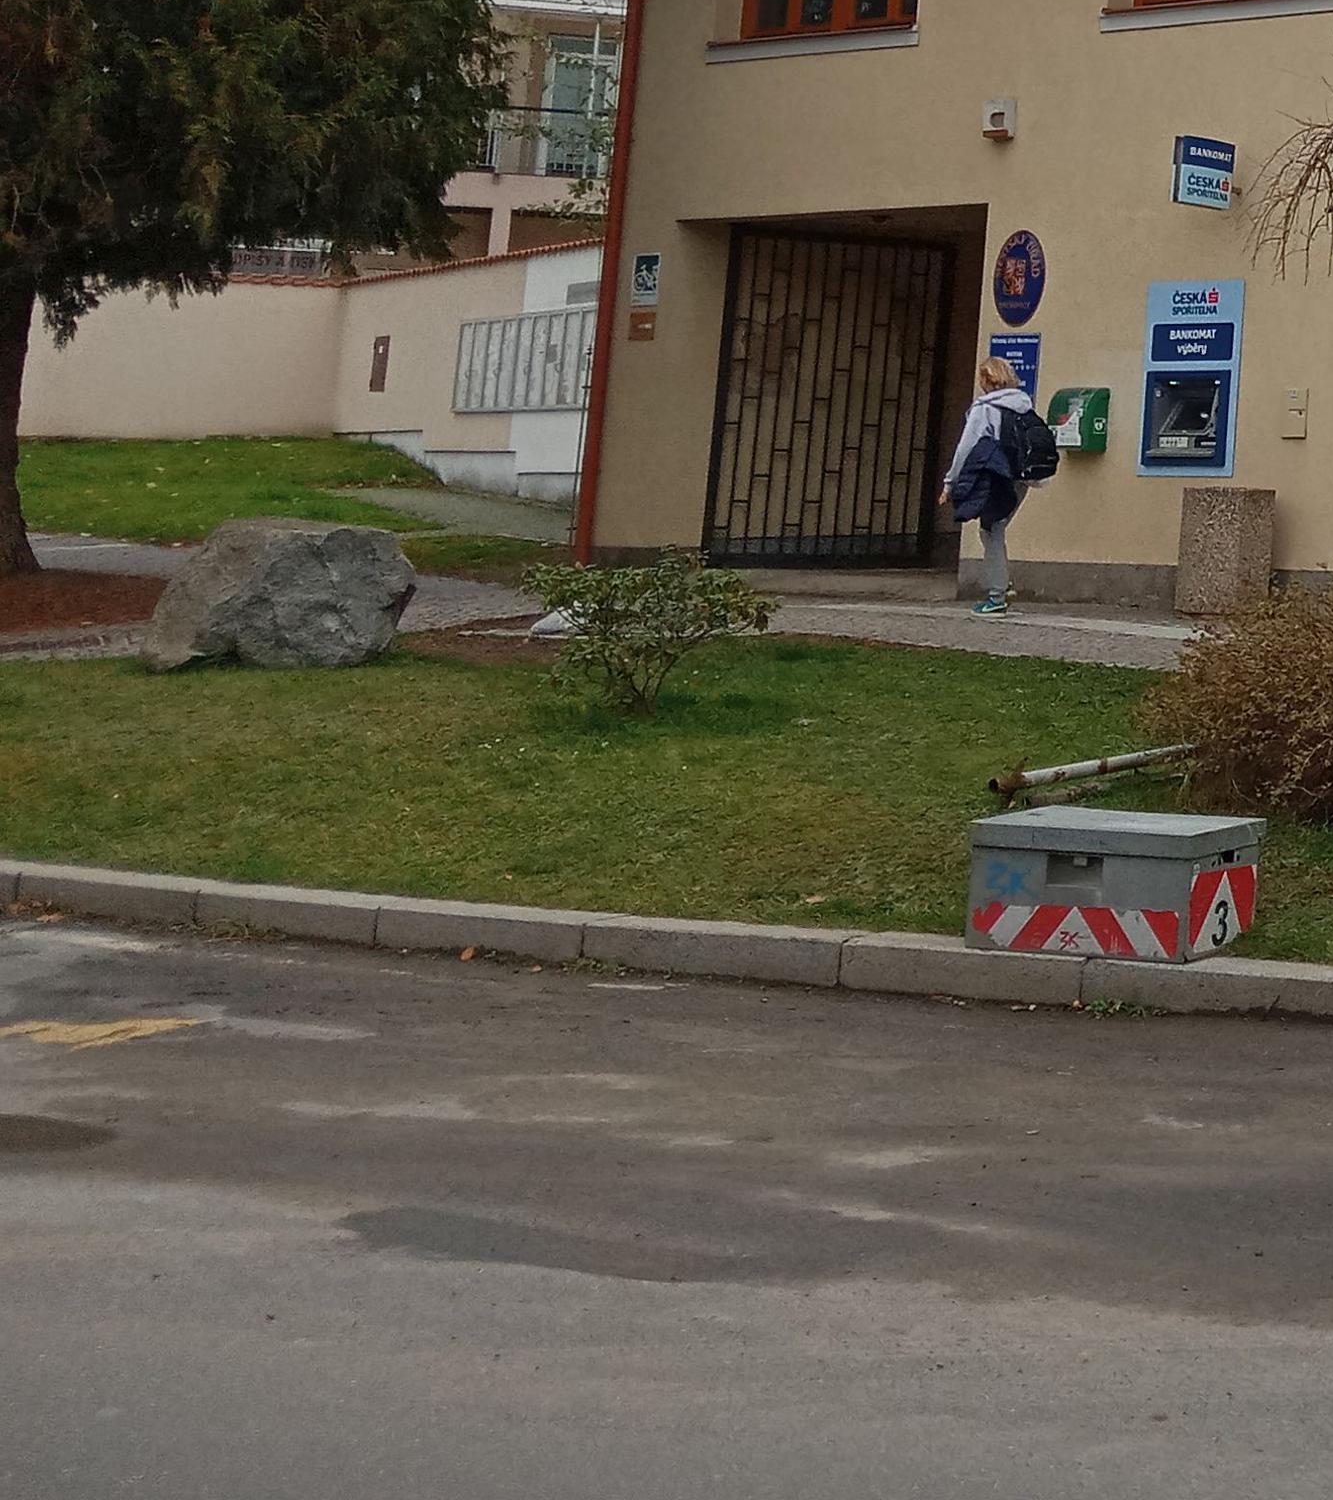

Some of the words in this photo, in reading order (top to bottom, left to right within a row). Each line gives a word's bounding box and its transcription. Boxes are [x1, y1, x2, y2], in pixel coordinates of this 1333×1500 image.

[1190, 146, 1232, 162] BANKOMAT
[1172, 290, 1207, 304] ČESKÁ
[1172, 305, 1217, 316] SPOŘITELNA
[1169, 329, 1217, 340] BANKOMAT
[1177, 343, 1208, 356] výběry
[1211, 900, 1229, 947] 3
